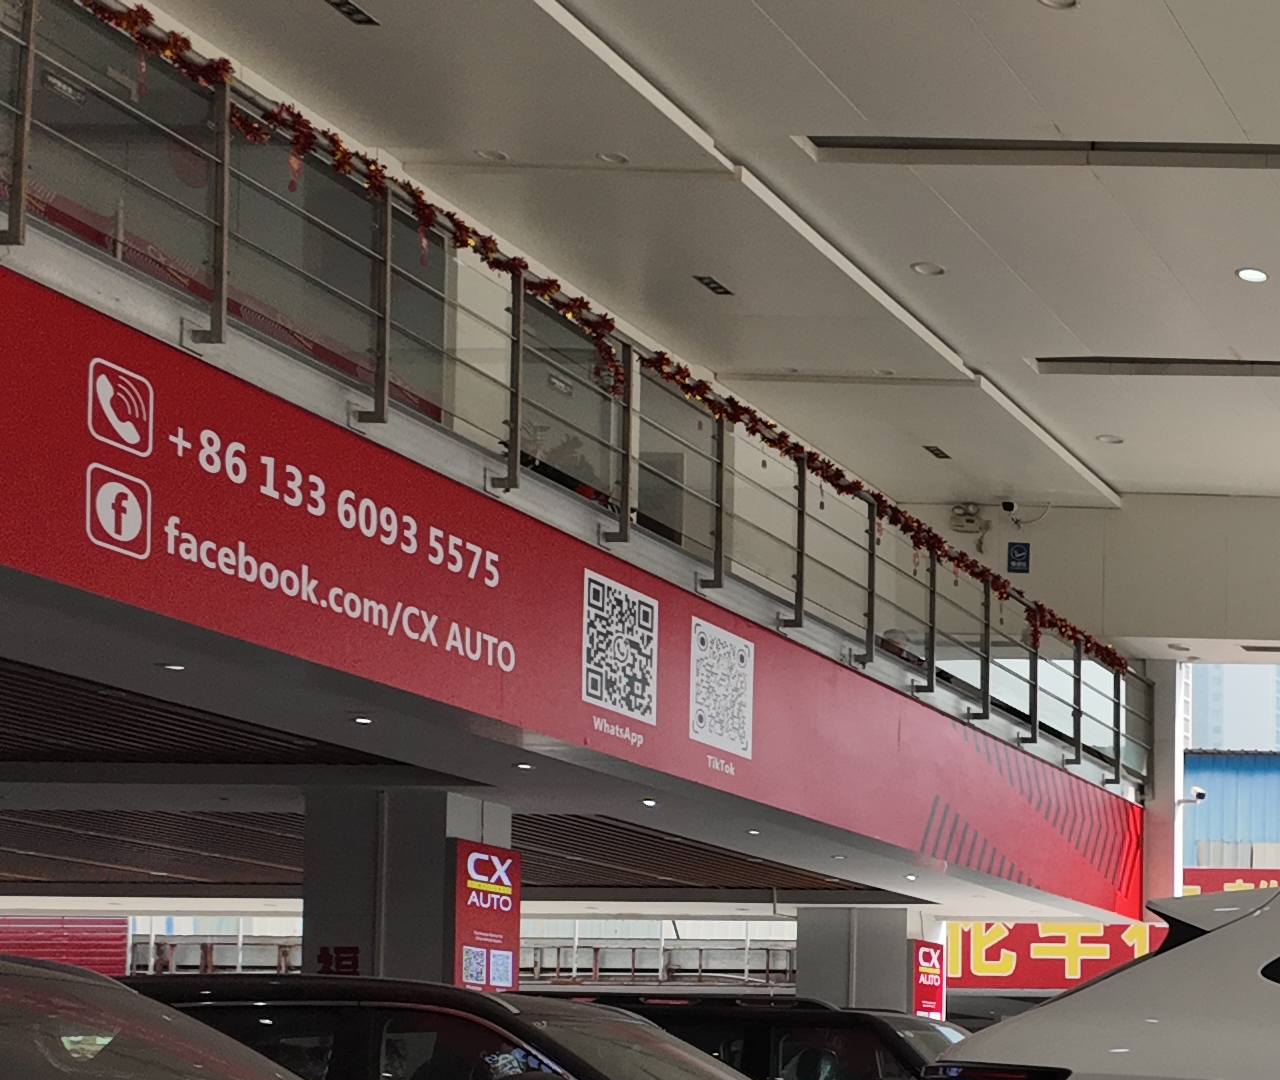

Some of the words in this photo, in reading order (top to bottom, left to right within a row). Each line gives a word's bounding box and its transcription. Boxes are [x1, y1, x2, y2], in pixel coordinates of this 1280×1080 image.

[168, 426, 247, 484] +86
[259, 455, 326, 517] 133
[337, 489, 418, 555] 6093
[428, 525, 500, 589] 5575
[445, 621, 516, 673] AUTO
[592, 715, 644, 748] WhatsApp
[706, 755, 736, 776] TikTok
[466, 852, 513, 887] CX
[467, 890, 513, 912] AUTO
[918, 946, 941, 969] CX
[918, 973, 941, 987] AUTO
